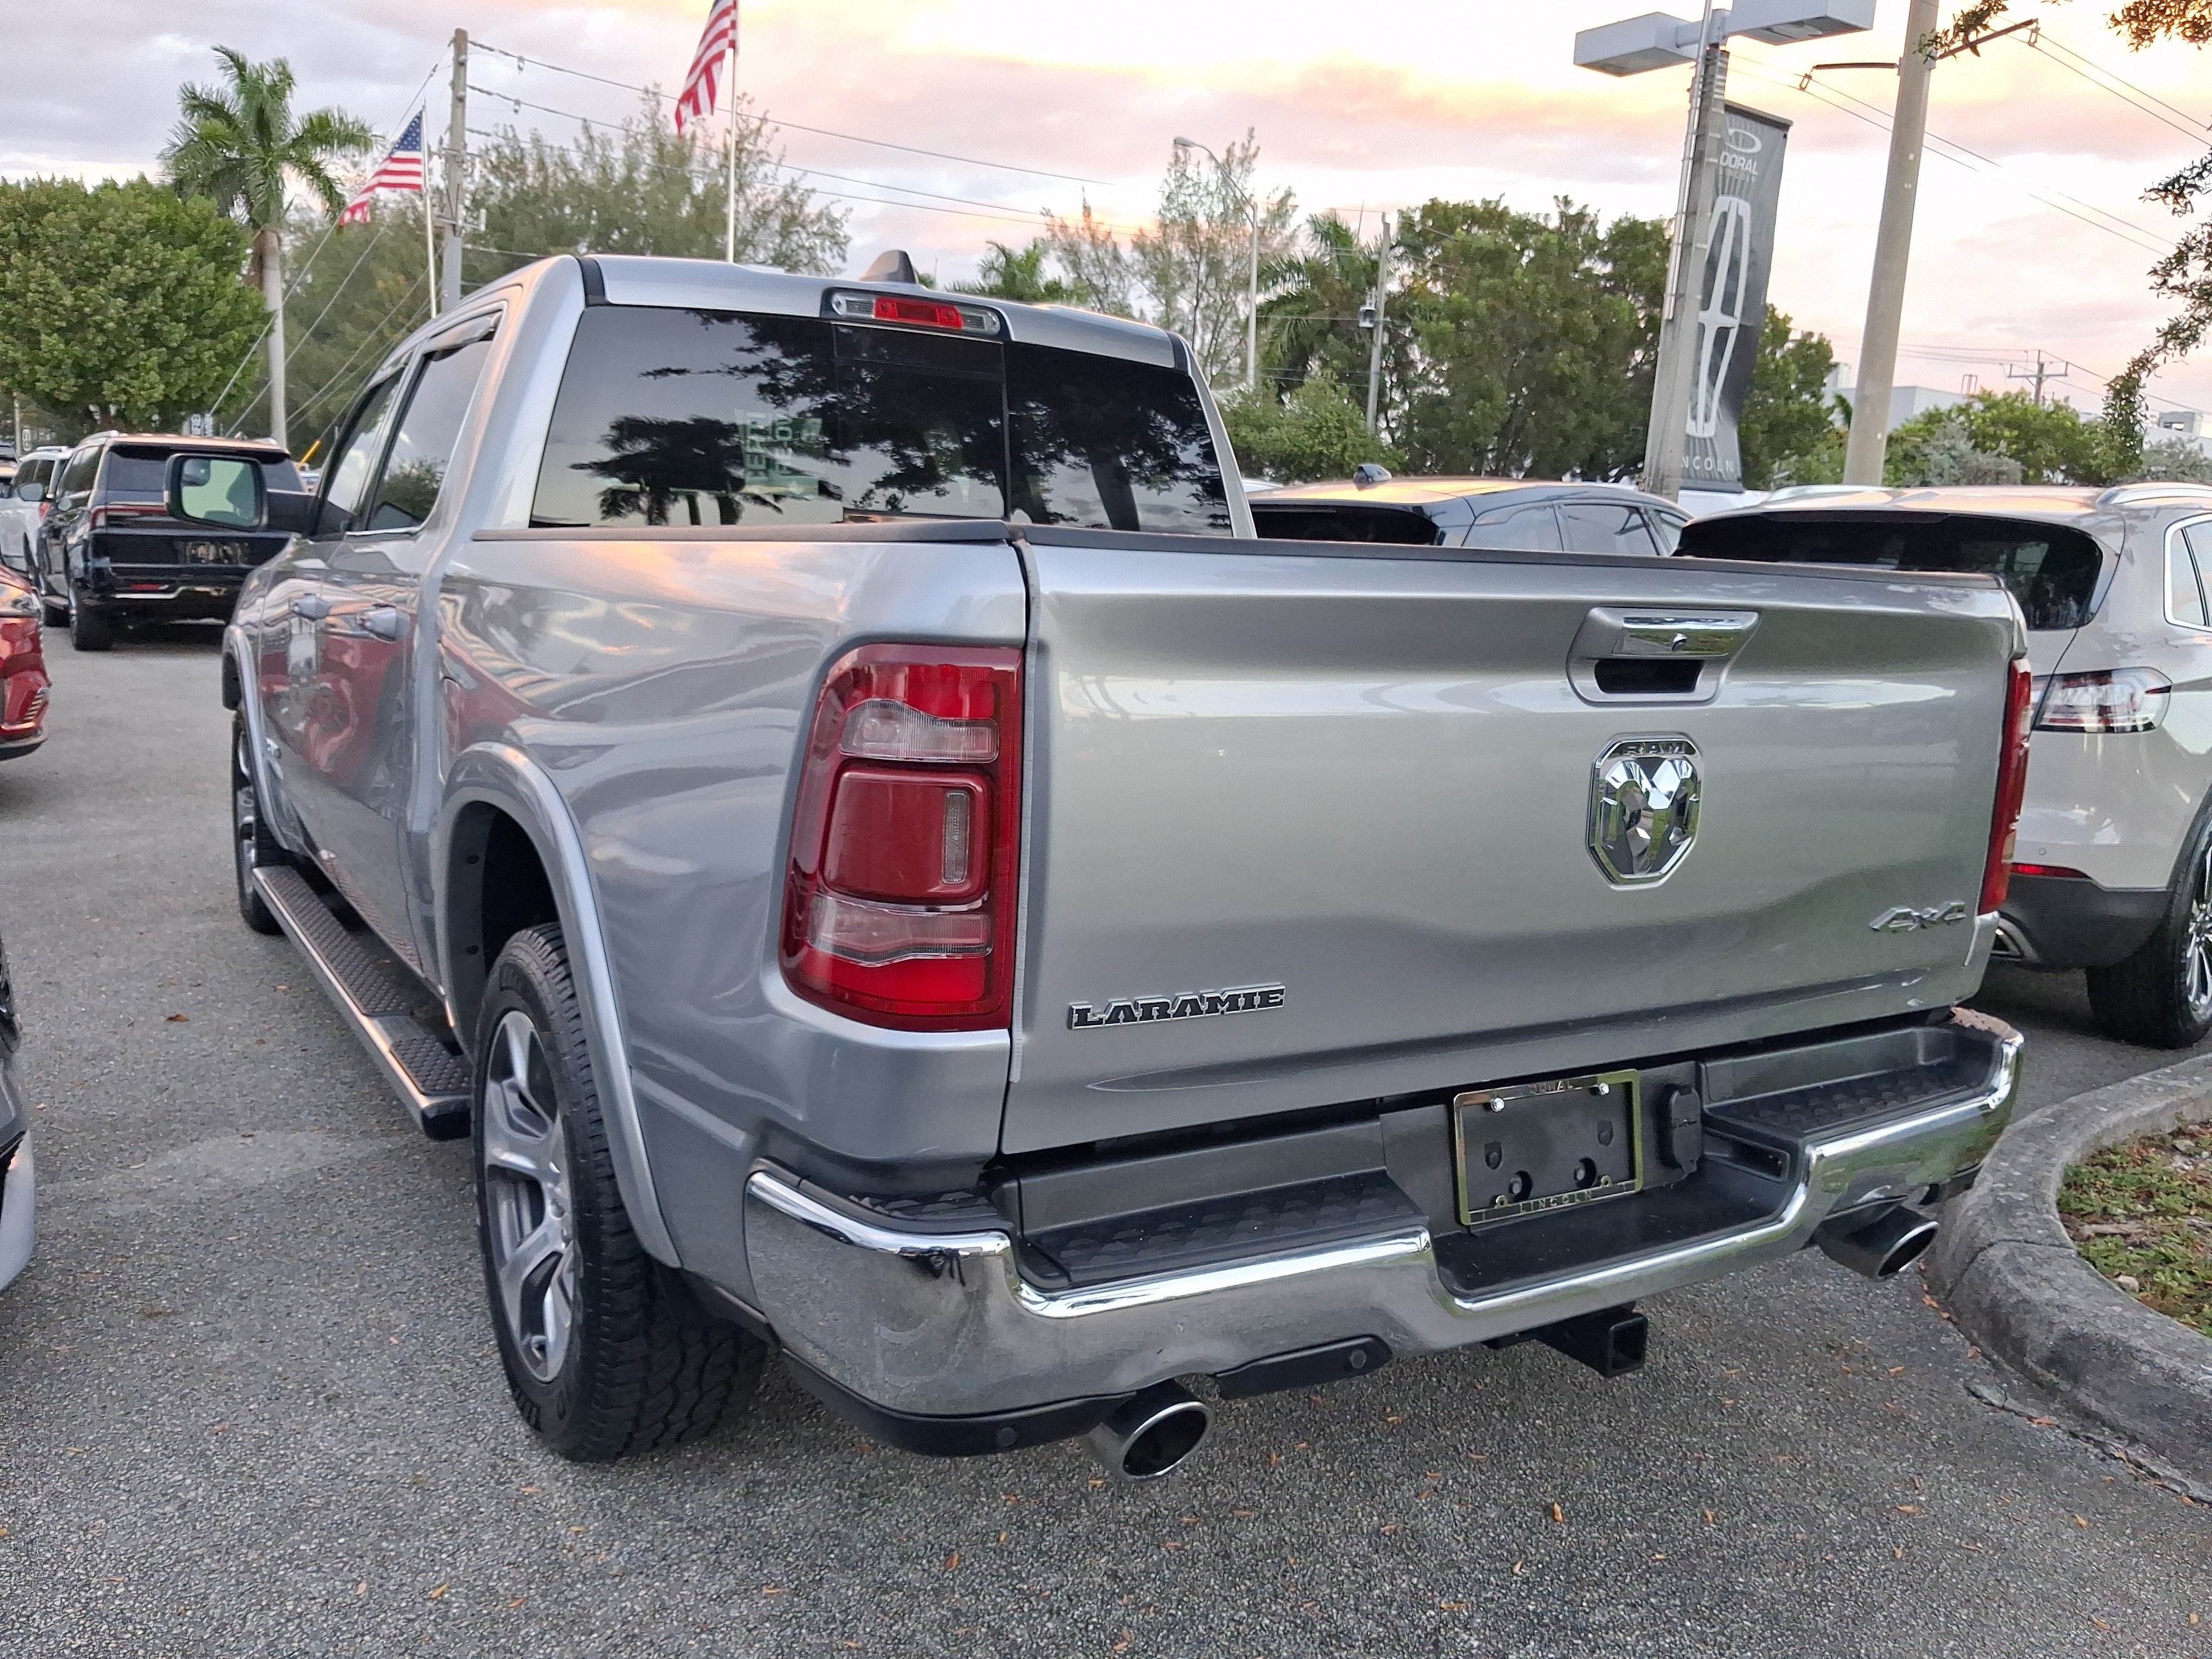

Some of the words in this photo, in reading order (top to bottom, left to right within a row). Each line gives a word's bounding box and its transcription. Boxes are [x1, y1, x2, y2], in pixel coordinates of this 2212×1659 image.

[1719, 151, 1758, 175] DORAL
[1681, 456, 1734, 472] NCOLN
[1623, 742, 1686, 756] RAM
[1068, 983, 1287, 1030] LARAMIE
[1520, 1190, 1592, 1213] LINCOLN
